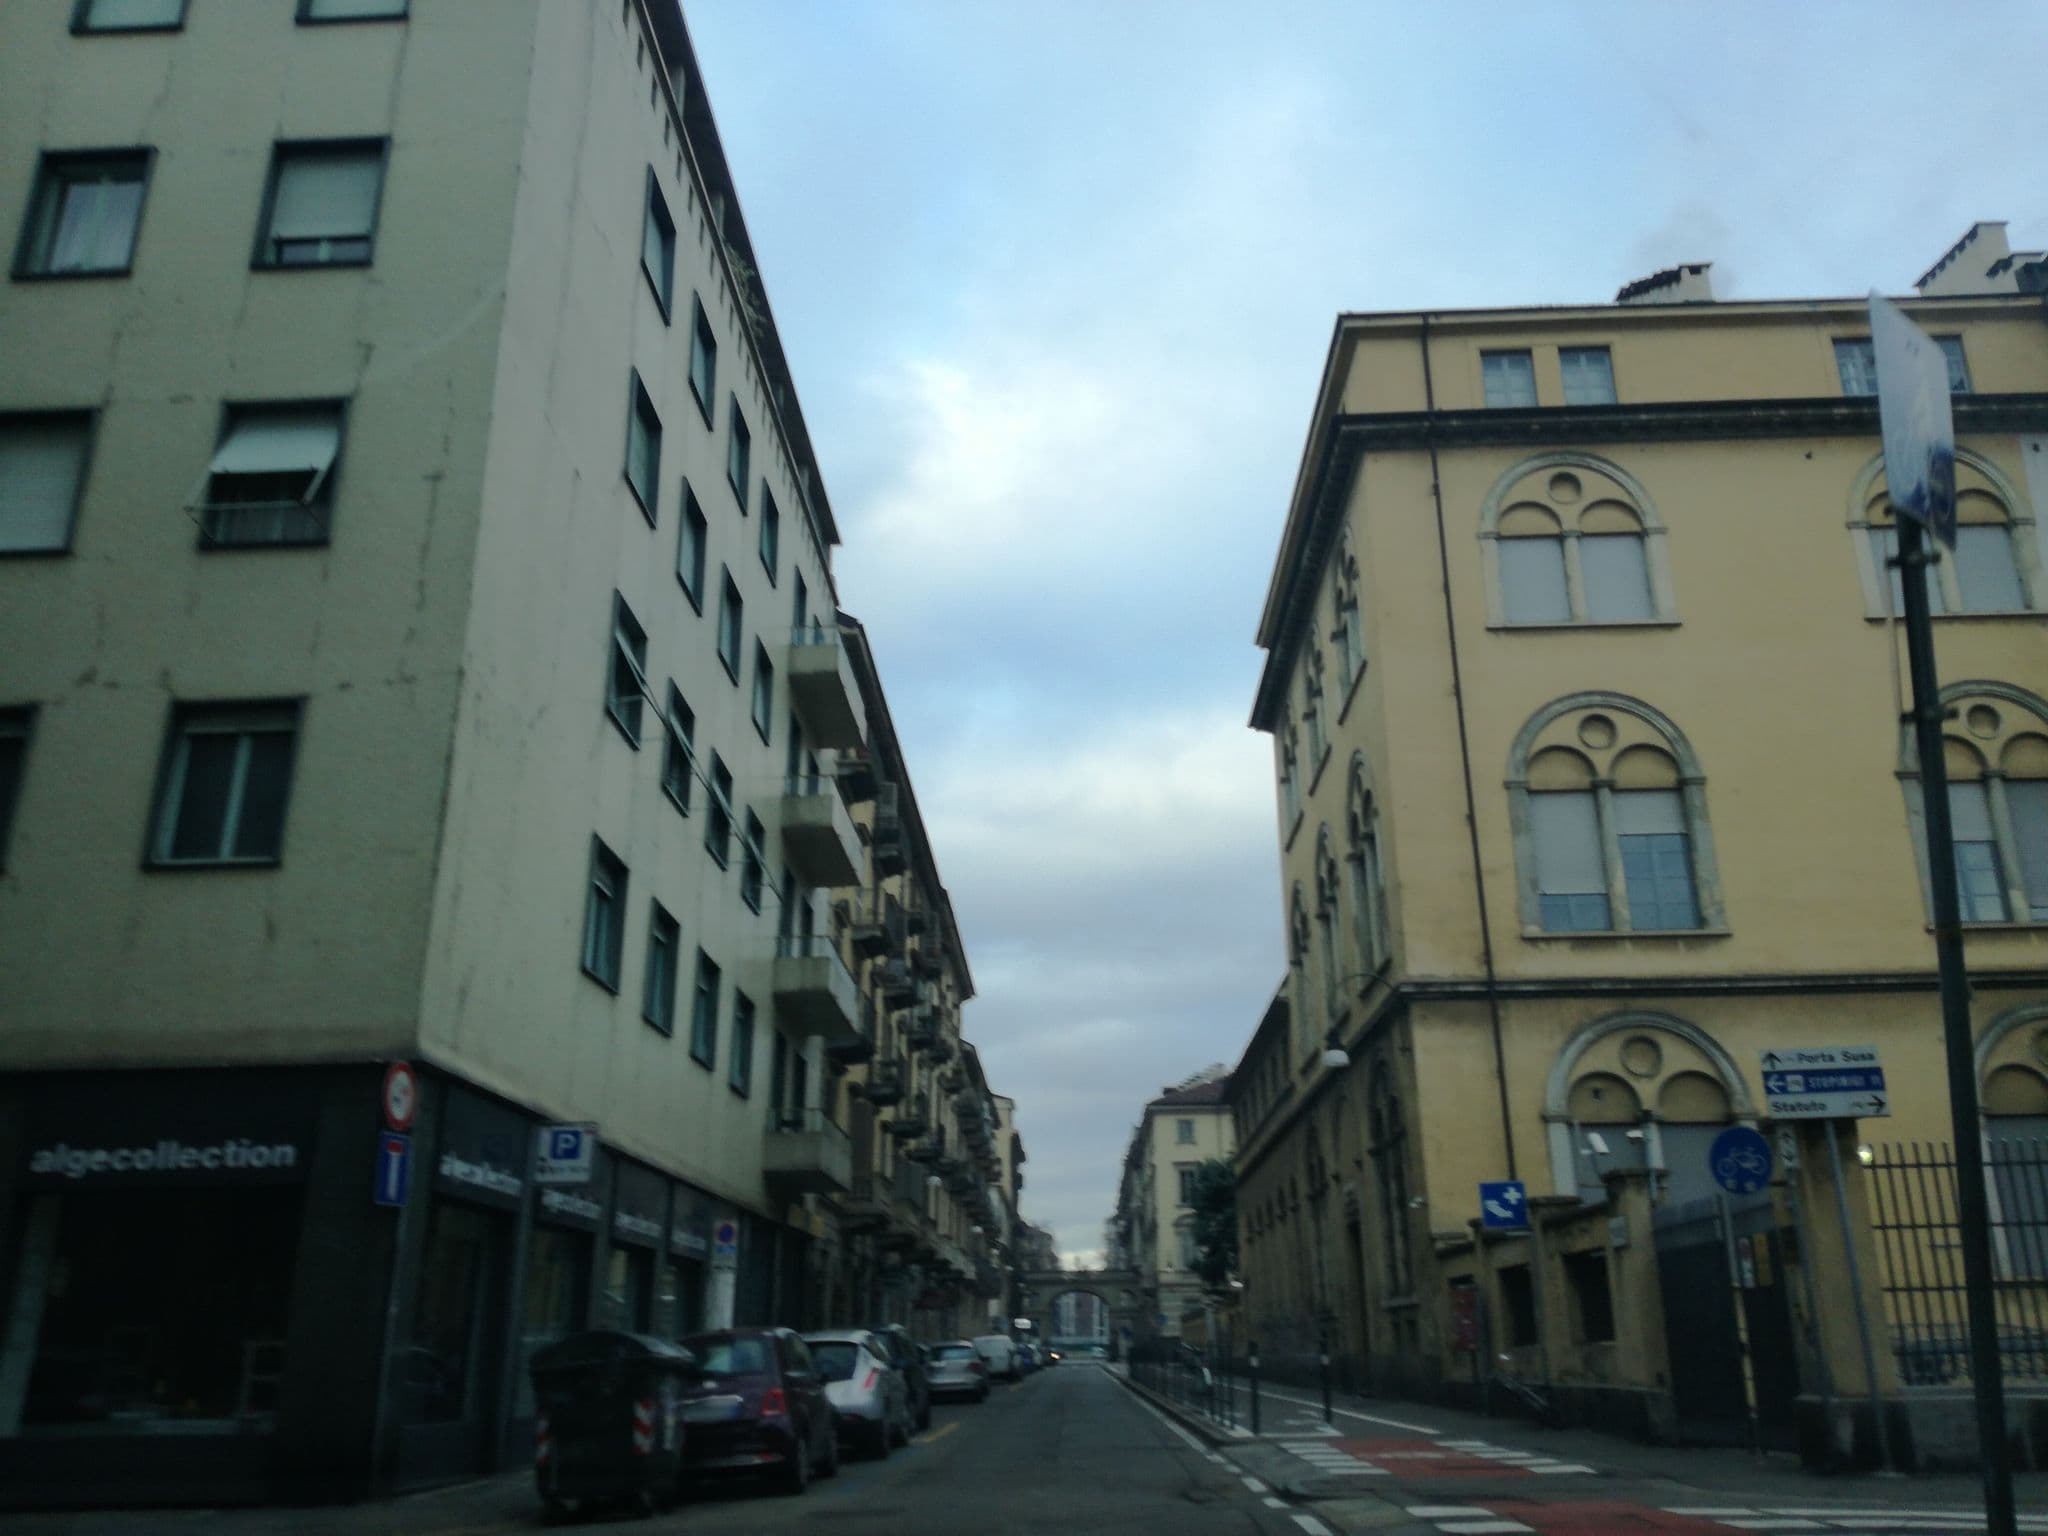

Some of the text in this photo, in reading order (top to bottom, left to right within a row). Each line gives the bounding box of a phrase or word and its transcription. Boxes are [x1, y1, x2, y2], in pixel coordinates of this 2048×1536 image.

[1797, 1050, 1875, 1064] Porta Susa
[1772, 1101, 1827, 1113] Statuto
[556, 1133, 577, 1156] P
[30, 1138, 298, 1178] algecollection
